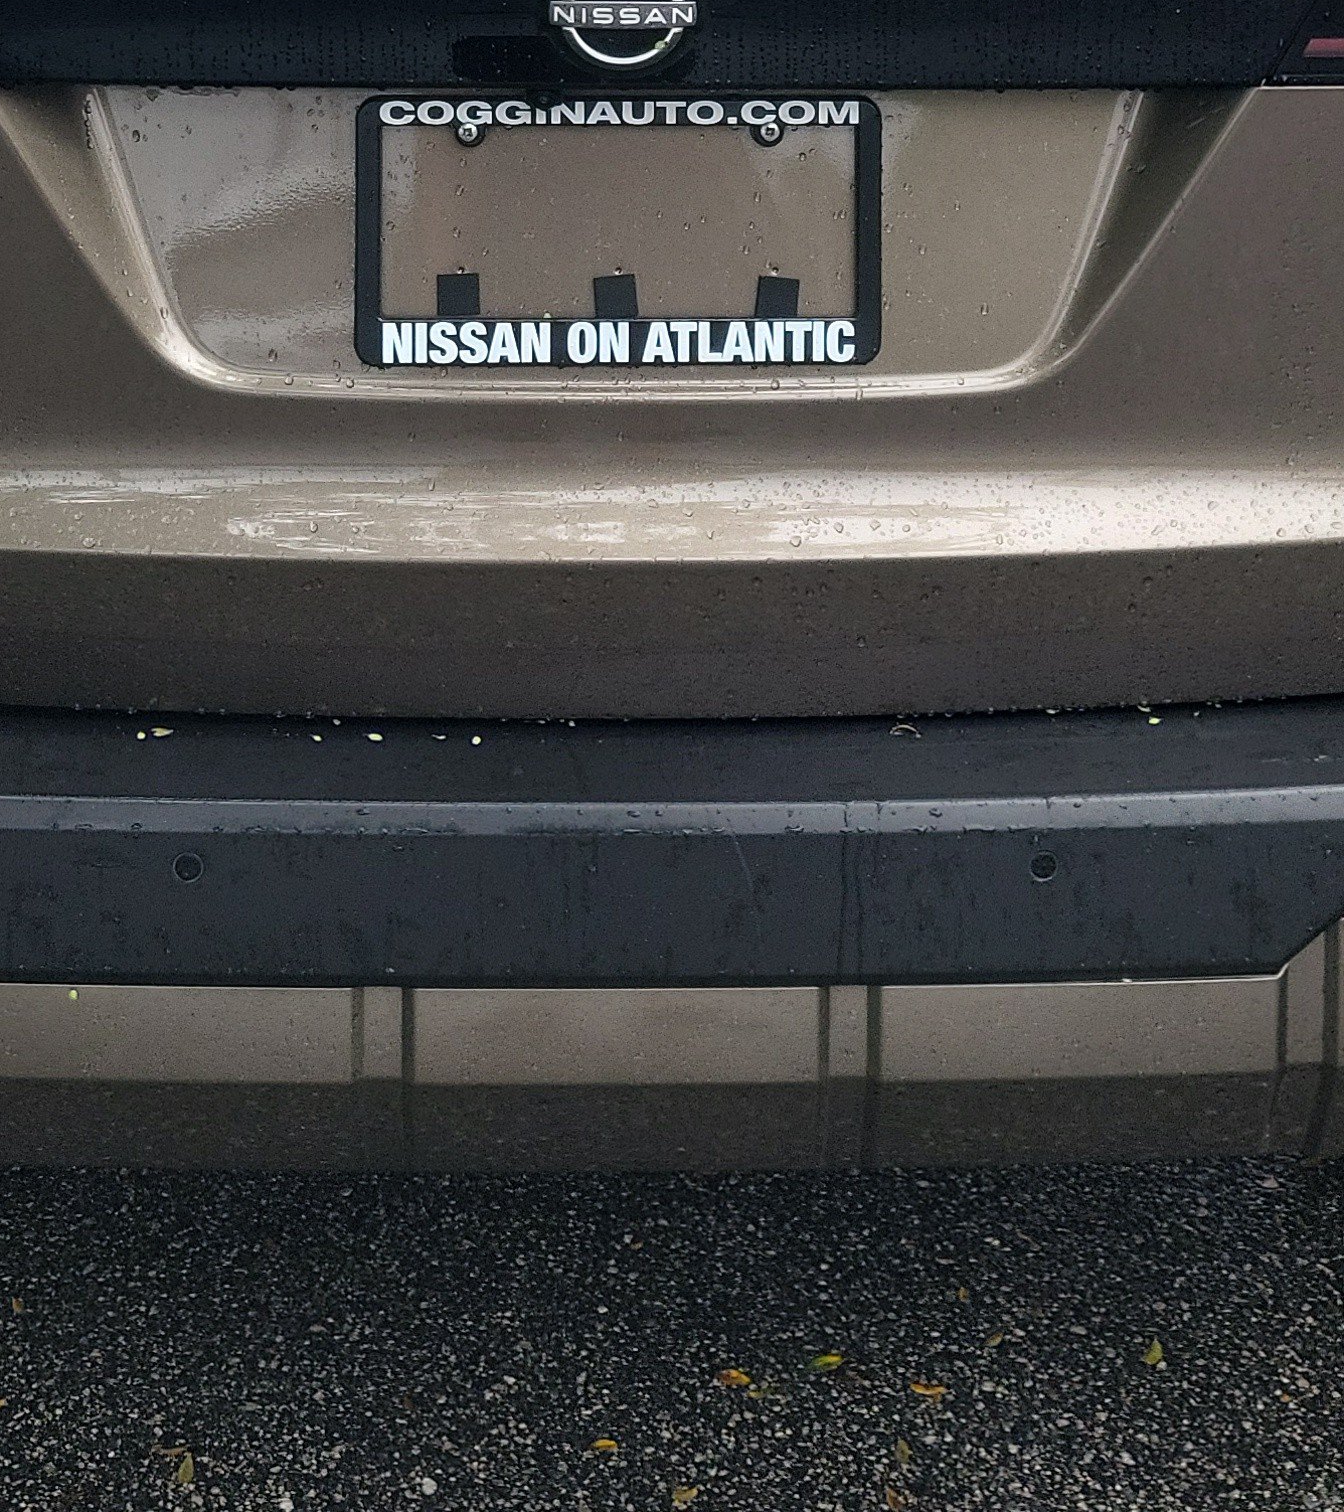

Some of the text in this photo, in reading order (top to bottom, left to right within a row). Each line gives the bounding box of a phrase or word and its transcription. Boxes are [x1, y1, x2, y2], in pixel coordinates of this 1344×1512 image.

[553, 5, 694, 24] NISSAN
[379, 100, 860, 125] COGGINAUTO.COM
[382, 321, 856, 364] NISSAN ON ATLANTIC
